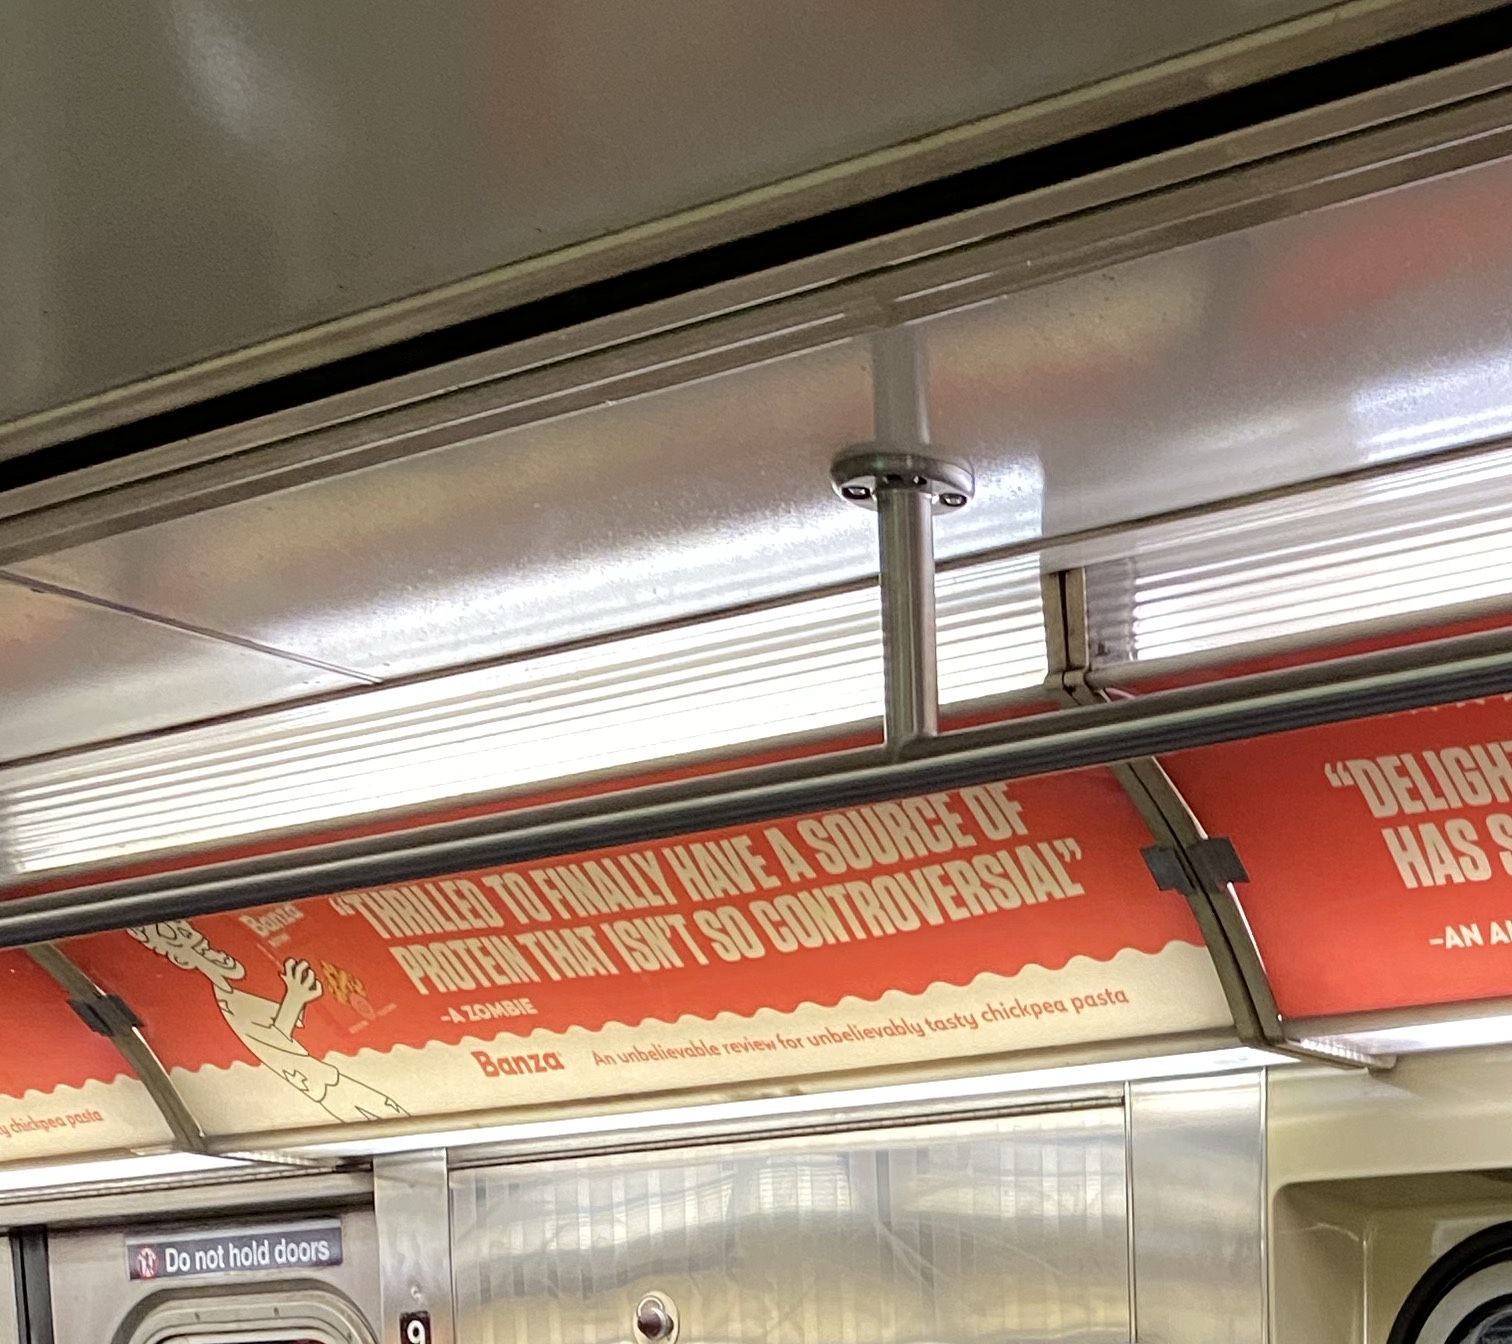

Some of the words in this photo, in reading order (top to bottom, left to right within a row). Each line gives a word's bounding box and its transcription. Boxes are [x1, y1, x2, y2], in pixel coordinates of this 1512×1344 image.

[329, 879, 504, 939] “THRILLED
[481, 872, 551, 924] TO
[529, 851, 677, 919] FINALLY
[661, 835, 781, 901] HAVE
[764, 827, 817, 882] A
[797, 793, 977, 874] SOURCE
[959, 782, 1028, 840] OF
[1381, 819, 1492, 889] HAS
[389, 935, 541, 995] PROTEIN
[514, 926, 620, 981] THAT
[600, 914, 710, 973] ISN’T
[693, 906, 765, 962] SO
[749, 837, 1085, 953] CONTROVERSIAL”
[461, 998, 538, 1023] ZOMBIE
[592, 1051, 617, 1067] An
[622, 1040, 721, 1064] unbelievable
[722, 1037, 776, 1055] review
[776, 1033, 803, 1050] for
[809, 1018, 926, 1047] unbelievably
[924, 1011, 979, 1033] tasty
[981, 1000, 1068, 1023] chickpea
[1070, 988, 1130, 1014] pasta
[471, 1051, 565, 1077] Banza
[10, 1115, 67, 1132] chickpea
[65, 1109, 104, 1128] pasta
[165, 1248, 190, 1273] Do
[195, 1245, 224, 1269] not
[229, 1241, 269, 1267] hold
[274, 1238, 330, 1264] doors
